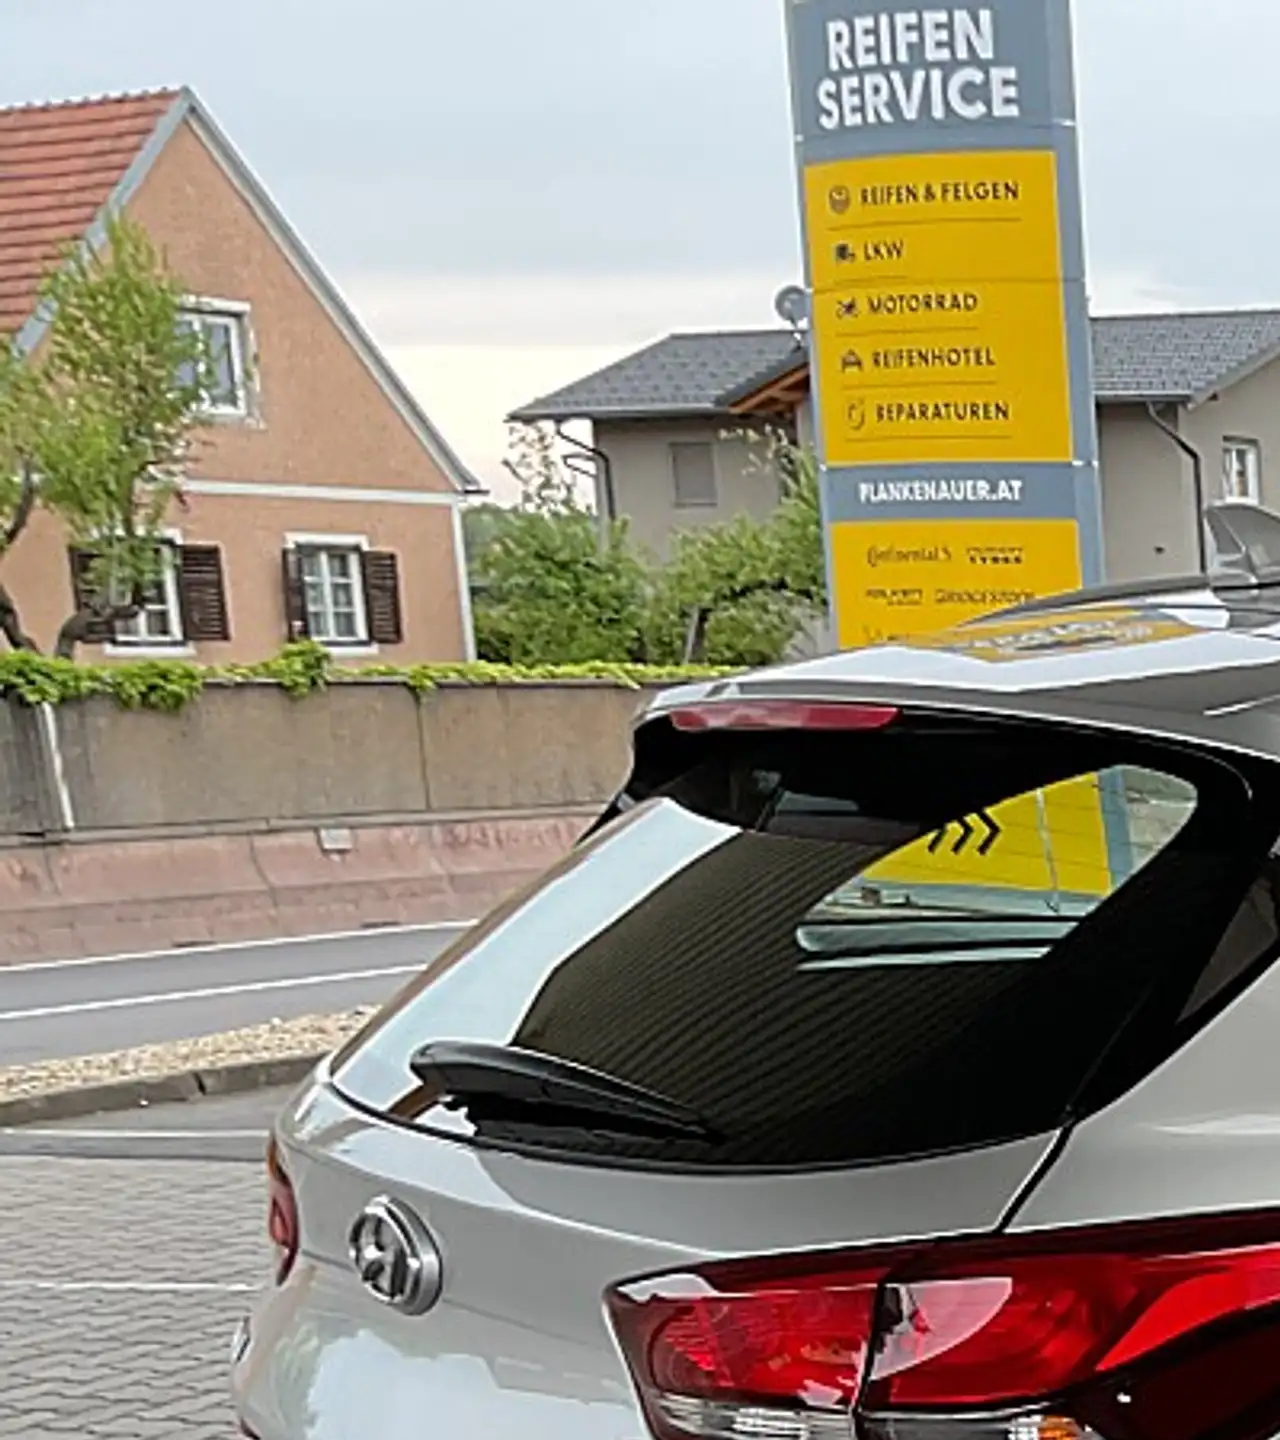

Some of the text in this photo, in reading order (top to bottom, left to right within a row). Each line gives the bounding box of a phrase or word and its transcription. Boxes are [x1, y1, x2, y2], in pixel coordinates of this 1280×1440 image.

[826, 9, 994, 71] REIFEN
[817, 66, 1020, 130] SERVICE
[861, 181, 1019, 206] REIFEN & FELGEN
[864, 240, 904, 261] LKW
[867, 291, 979, 314] MOTORRAD
[872, 347, 996, 369] REIFENHOTEL
[876, 401, 1010, 423] REPARATUREN
[859, 479, 1023, 504] PLANKENAUER.AT
